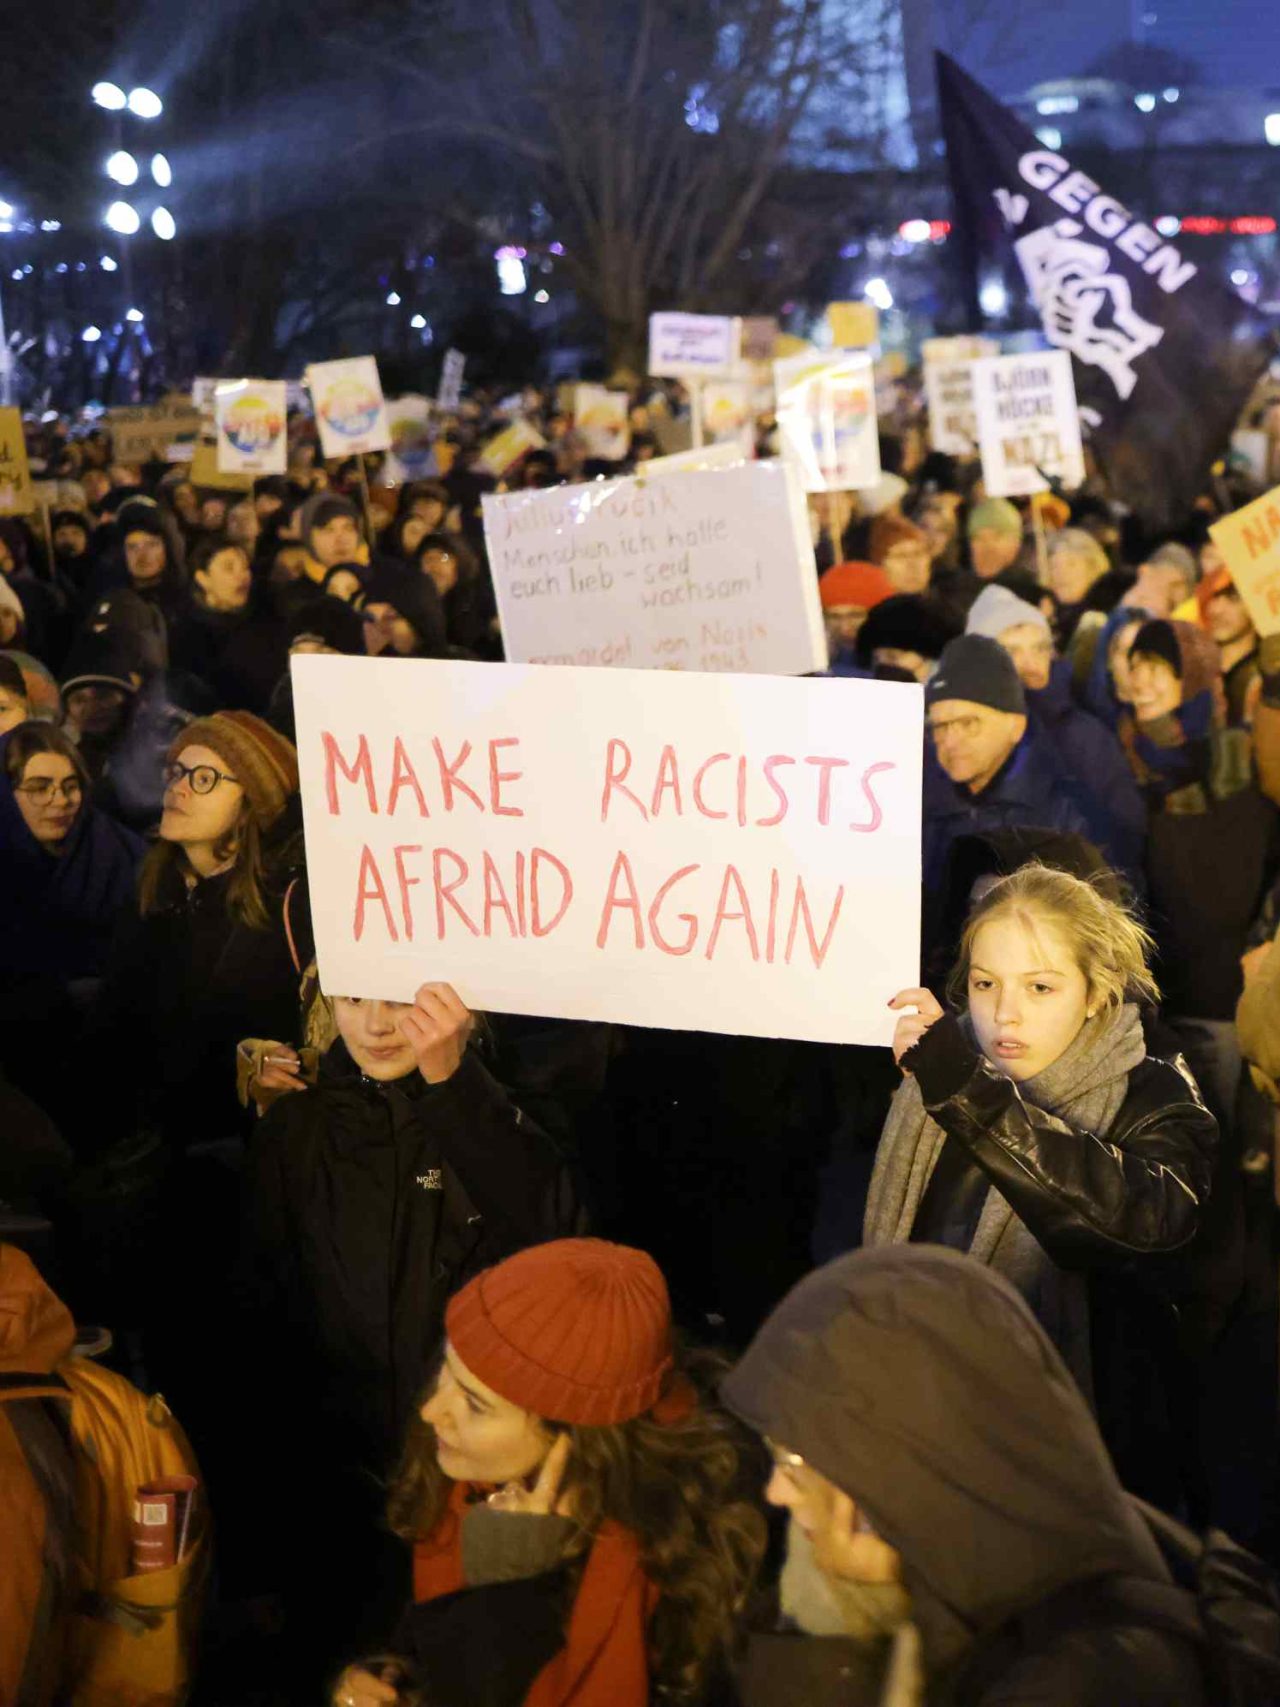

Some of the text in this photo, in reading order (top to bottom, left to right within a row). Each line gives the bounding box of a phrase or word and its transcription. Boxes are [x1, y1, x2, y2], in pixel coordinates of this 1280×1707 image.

[1018, 150, 1198, 293] GEGEN
[510, 571, 561, 599] euch
[569, 561, 613, 593] lieb
[321, 731, 896, 832] MAKE RACISTS
[354, 844, 844, 969] AFRAID AGAIN
